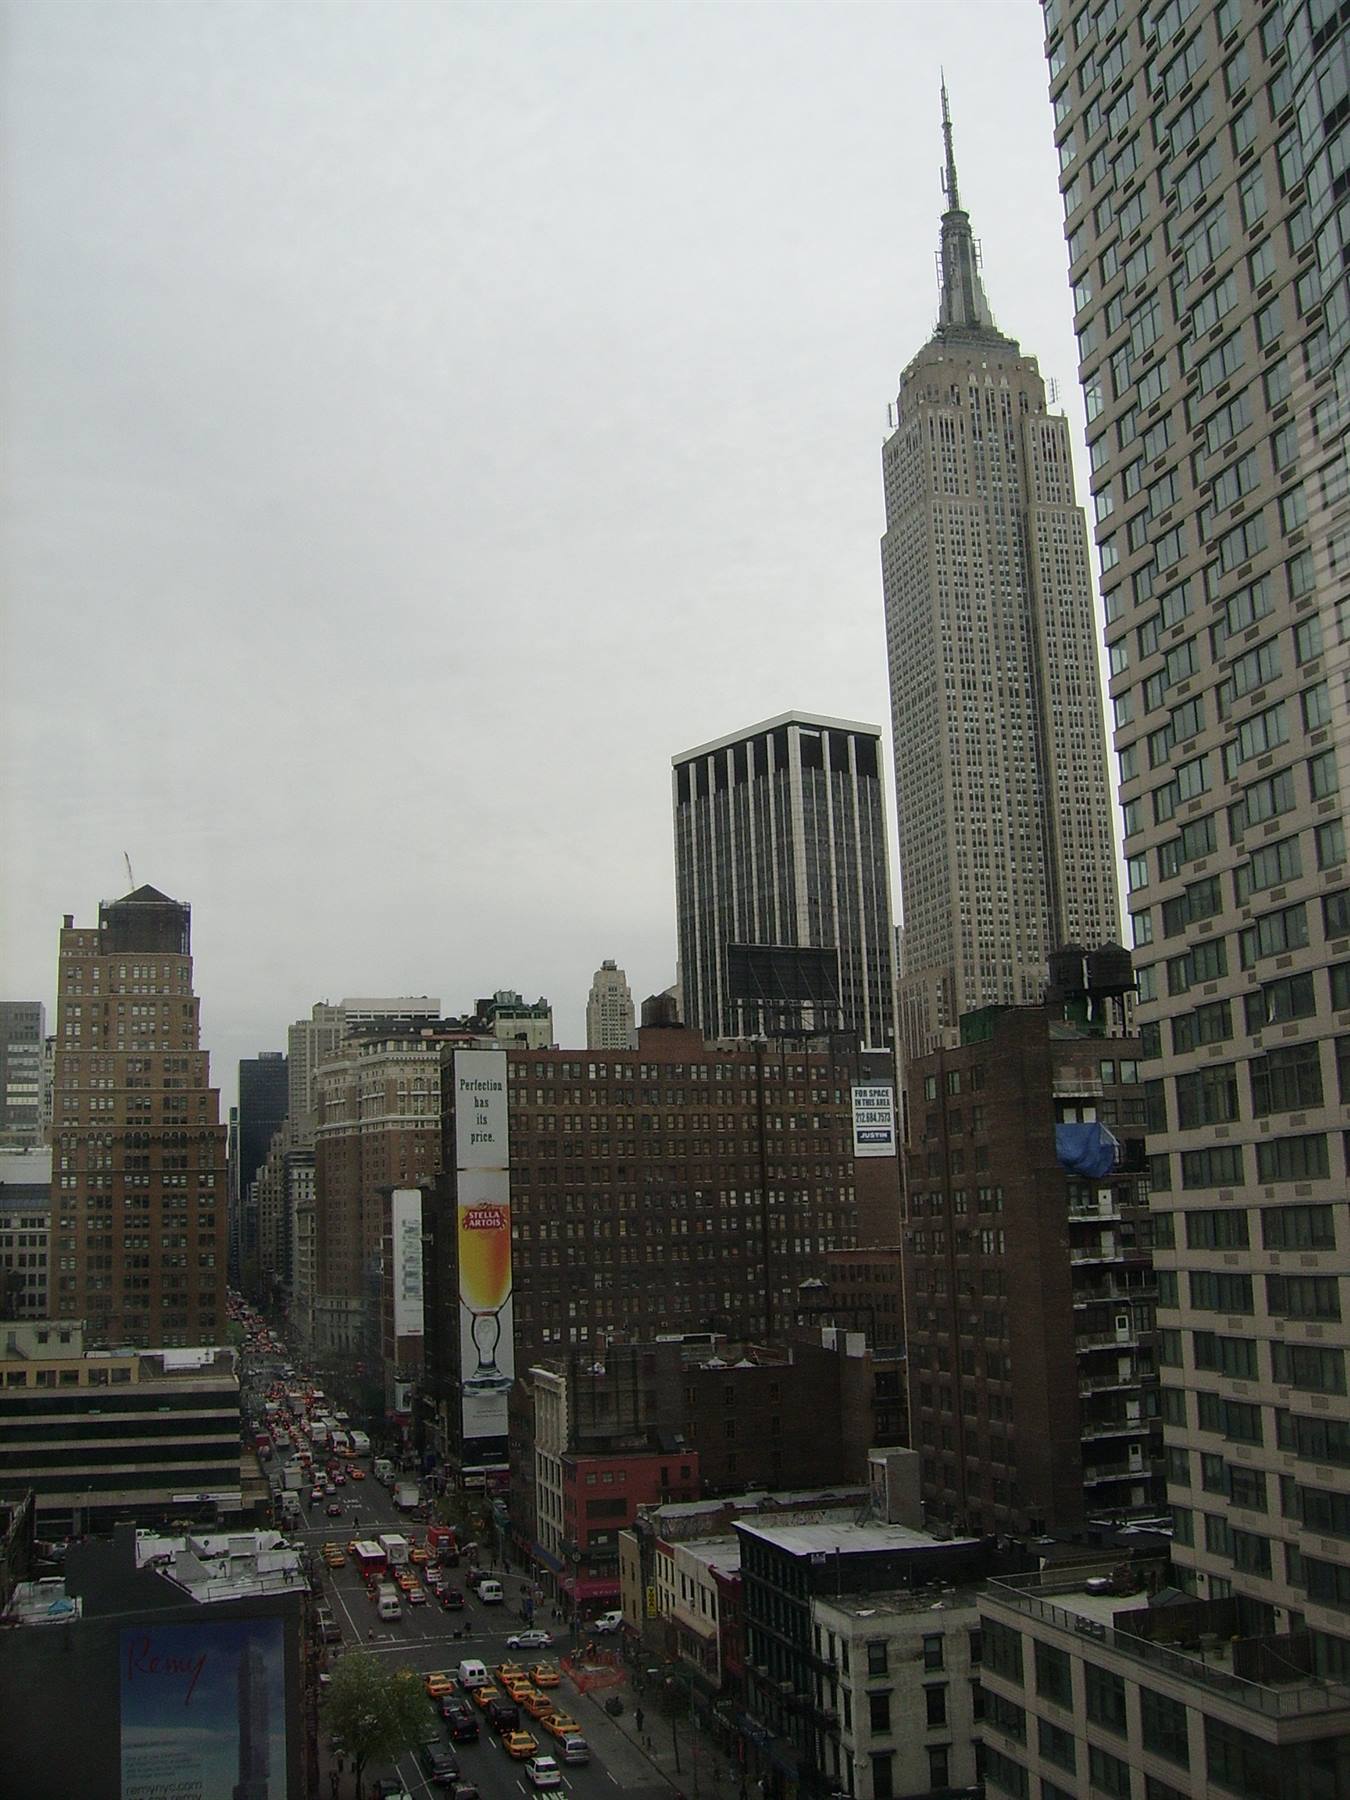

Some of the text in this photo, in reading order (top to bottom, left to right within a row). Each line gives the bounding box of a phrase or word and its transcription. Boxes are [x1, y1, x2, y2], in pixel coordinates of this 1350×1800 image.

[459, 1078, 503, 1092] Perfection
[869, 1089, 889, 1097] SPACE
[474, 1096, 489, 1108] has
[862, 1098, 875, 1106] THIS
[876, 1098, 890, 1106] AREA
[476, 1113, 488, 1127] its
[470, 1131, 495, 1144] price.
[468, 1211, 500, 1219] STELLA
[468, 1218, 501, 1227] ARTOIS
[127, 1633, 208, 1705] Remy
